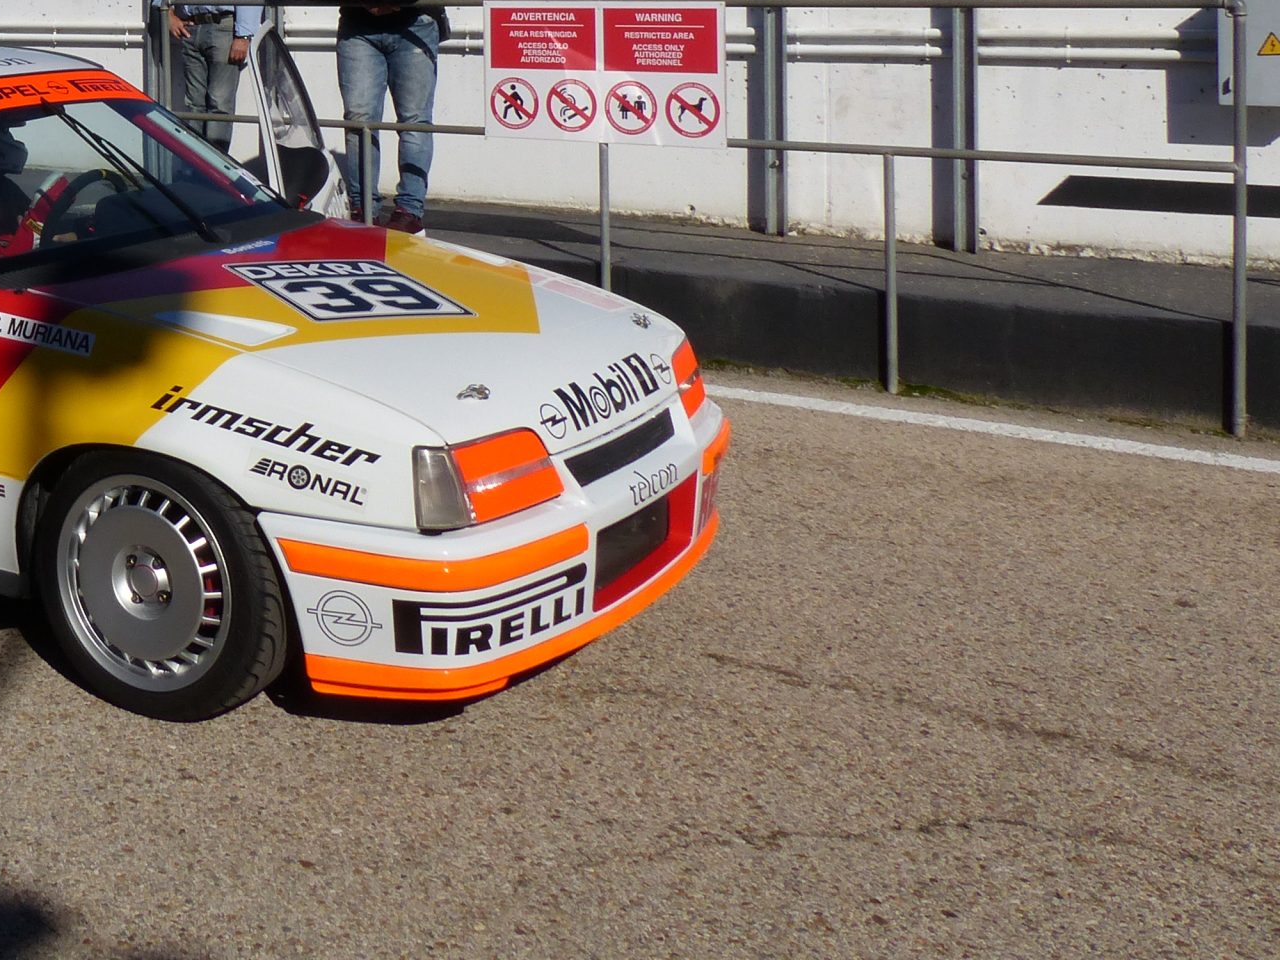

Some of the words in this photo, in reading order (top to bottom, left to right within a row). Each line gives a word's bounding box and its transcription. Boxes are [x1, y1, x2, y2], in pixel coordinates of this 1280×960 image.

[510, 12, 575, 21] ADVERTENCIA
[635, 13, 682, 22] WARNING
[509, 30, 529, 38] AREA
[529, 30, 577, 38] RESTRINGIDA
[624, 31, 671, 39] RESTRICTED
[672, 32, 695, 40] AREA
[548, 42, 568, 50] SOLO
[632, 43, 663, 51] ACCESS
[634, 51, 682, 59] AUTHORIZED
[520, 56, 566, 64] AUTORIZADO
[636, 58, 683, 66] PERSONNEL
[234, 262, 398, 279] DEKRA
[281, 278, 444, 313] 39
[7, 317, 91, 354] MURIANA
[553, 362, 640, 431] Mobil
[150, 385, 382, 466] irmscher
[391, 562, 587, 656] PIRELLI
